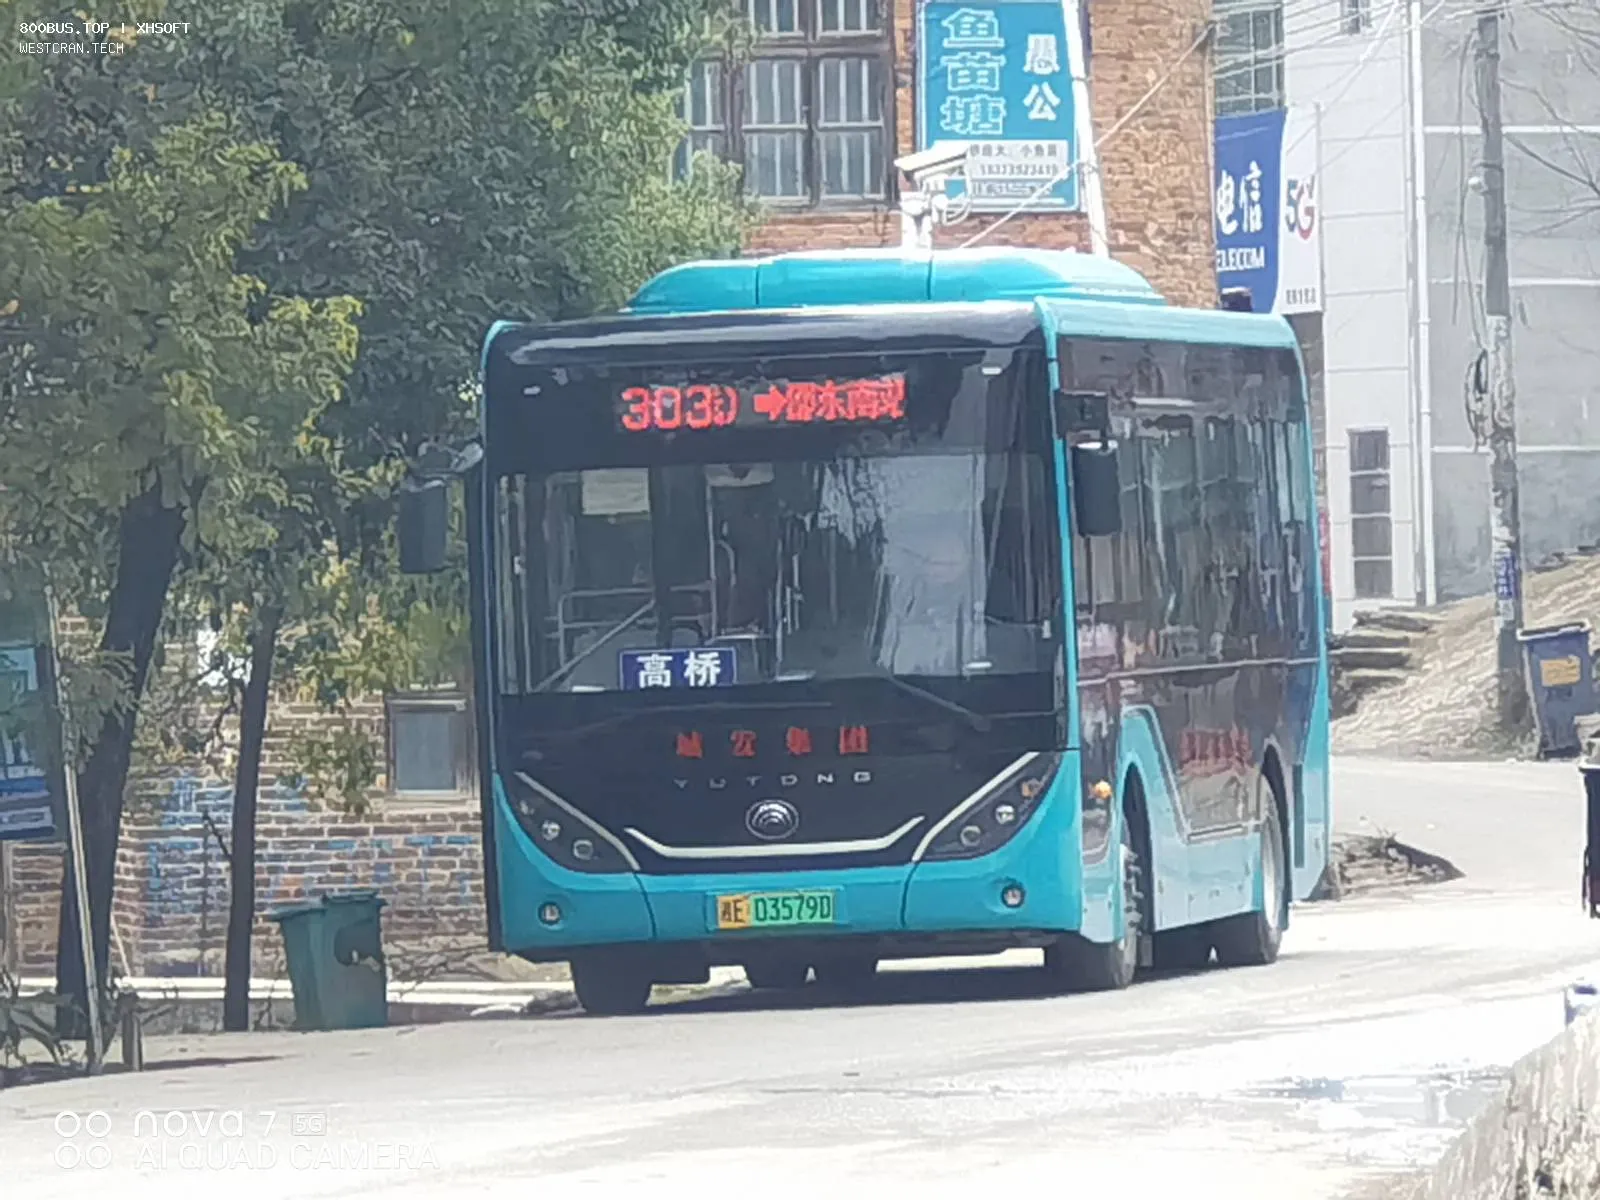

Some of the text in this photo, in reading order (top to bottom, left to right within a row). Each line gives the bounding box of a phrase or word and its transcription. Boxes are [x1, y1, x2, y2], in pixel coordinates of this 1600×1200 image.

[1023, 33, 1061, 121] 愚公
[1285, 176, 1315, 240] 5G
[636, 651, 721, 689] 高桥
[674, 771, 872, 789] YUTONG
